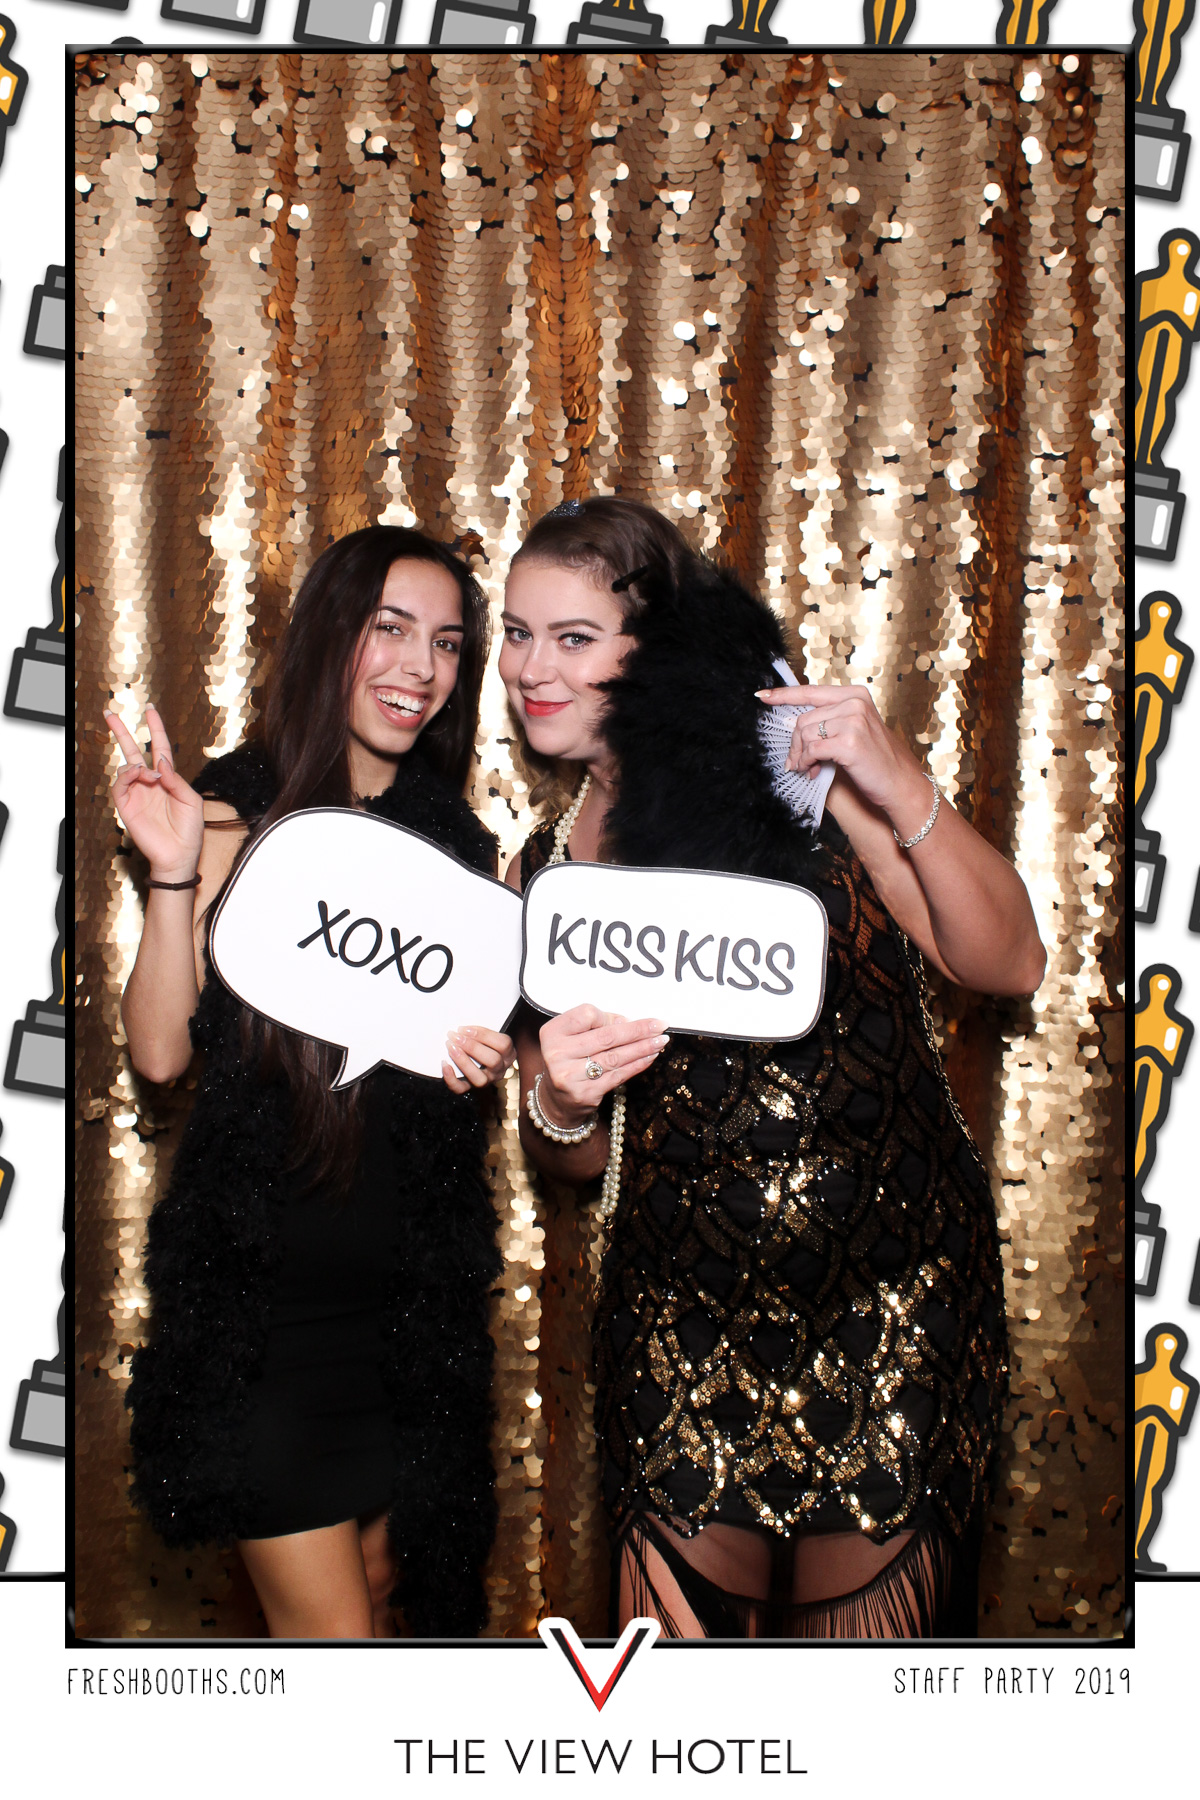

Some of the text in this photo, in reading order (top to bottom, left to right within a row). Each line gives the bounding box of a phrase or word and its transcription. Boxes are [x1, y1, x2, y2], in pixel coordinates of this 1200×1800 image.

[297, 901, 453, 993] XOXO
[548, 912, 795, 995] KISS KISS
